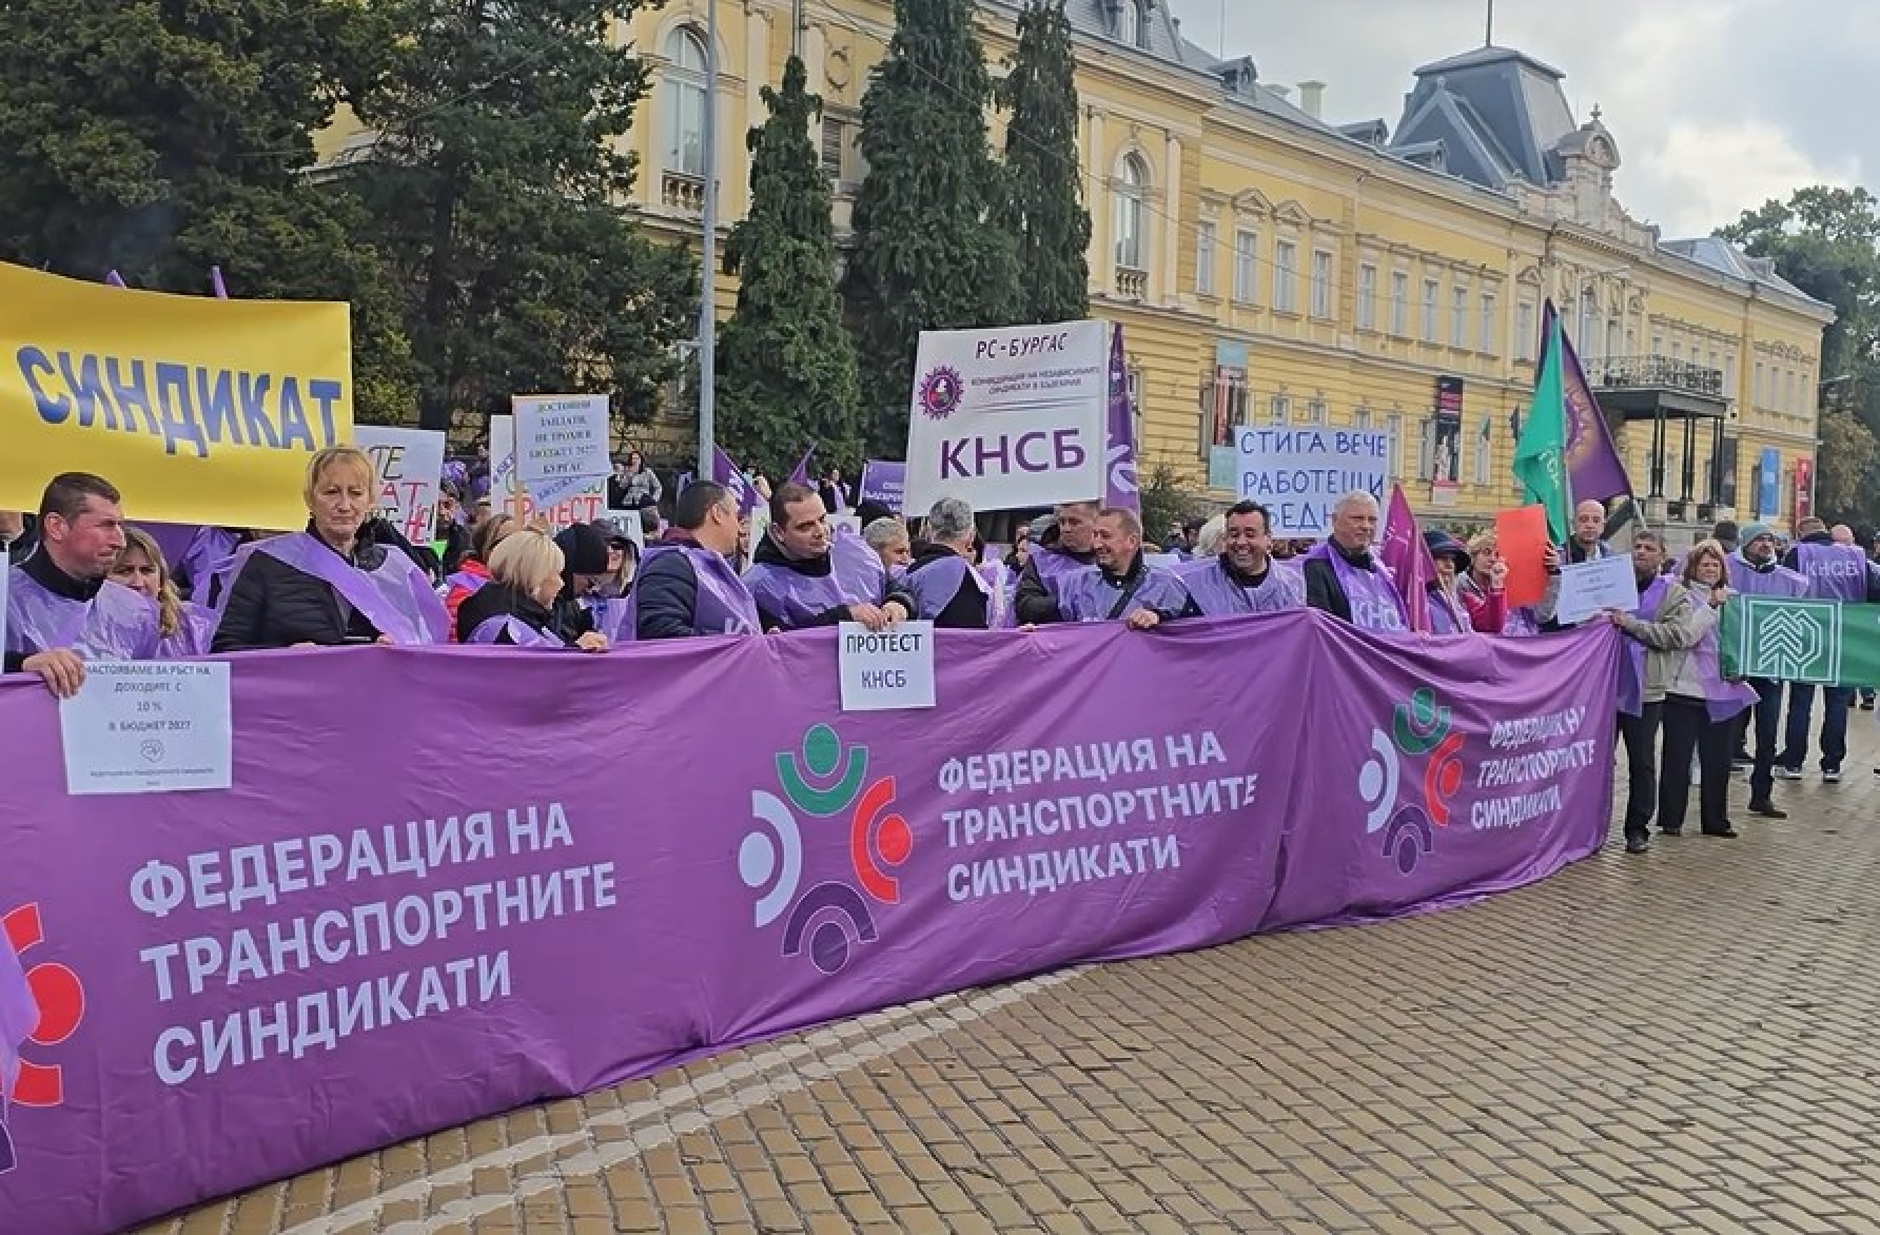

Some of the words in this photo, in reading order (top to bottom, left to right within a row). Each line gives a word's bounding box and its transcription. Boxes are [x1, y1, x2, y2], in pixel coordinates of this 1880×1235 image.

[976, 333, 1068, 359] РС-БУРГАС
[16, 344, 343, 458] СИНДИКАТ
[941, 428, 1086, 479] КНСБ
[1241, 432, 1327, 454] СТИГА
[1335, 432, 1387, 457] ВЕЧЕ
[1806, 560, 1859, 576] КНСБ
[846, 634, 922, 655] ПРОТЕСТ
[136, 701, 149, 711] 10
[861, 669, 906, 689] КНСБ
[938, 738, 1158, 794] ФЕДЕРАЦИЯ
[1164, 730, 1227, 768] НА
[942, 773, 1258, 847] ТРАНСПОРТНИТЕ
[129, 810, 496, 918] ФЕДЕРАЦИЯ
[507, 802, 574, 855] НА
[948, 834, 1181, 901] СИНДИКАТИ
[140, 861, 617, 1002] ТРАНСПОРТНИТЕ
[153, 950, 512, 1084] СИНДИКАТИ
